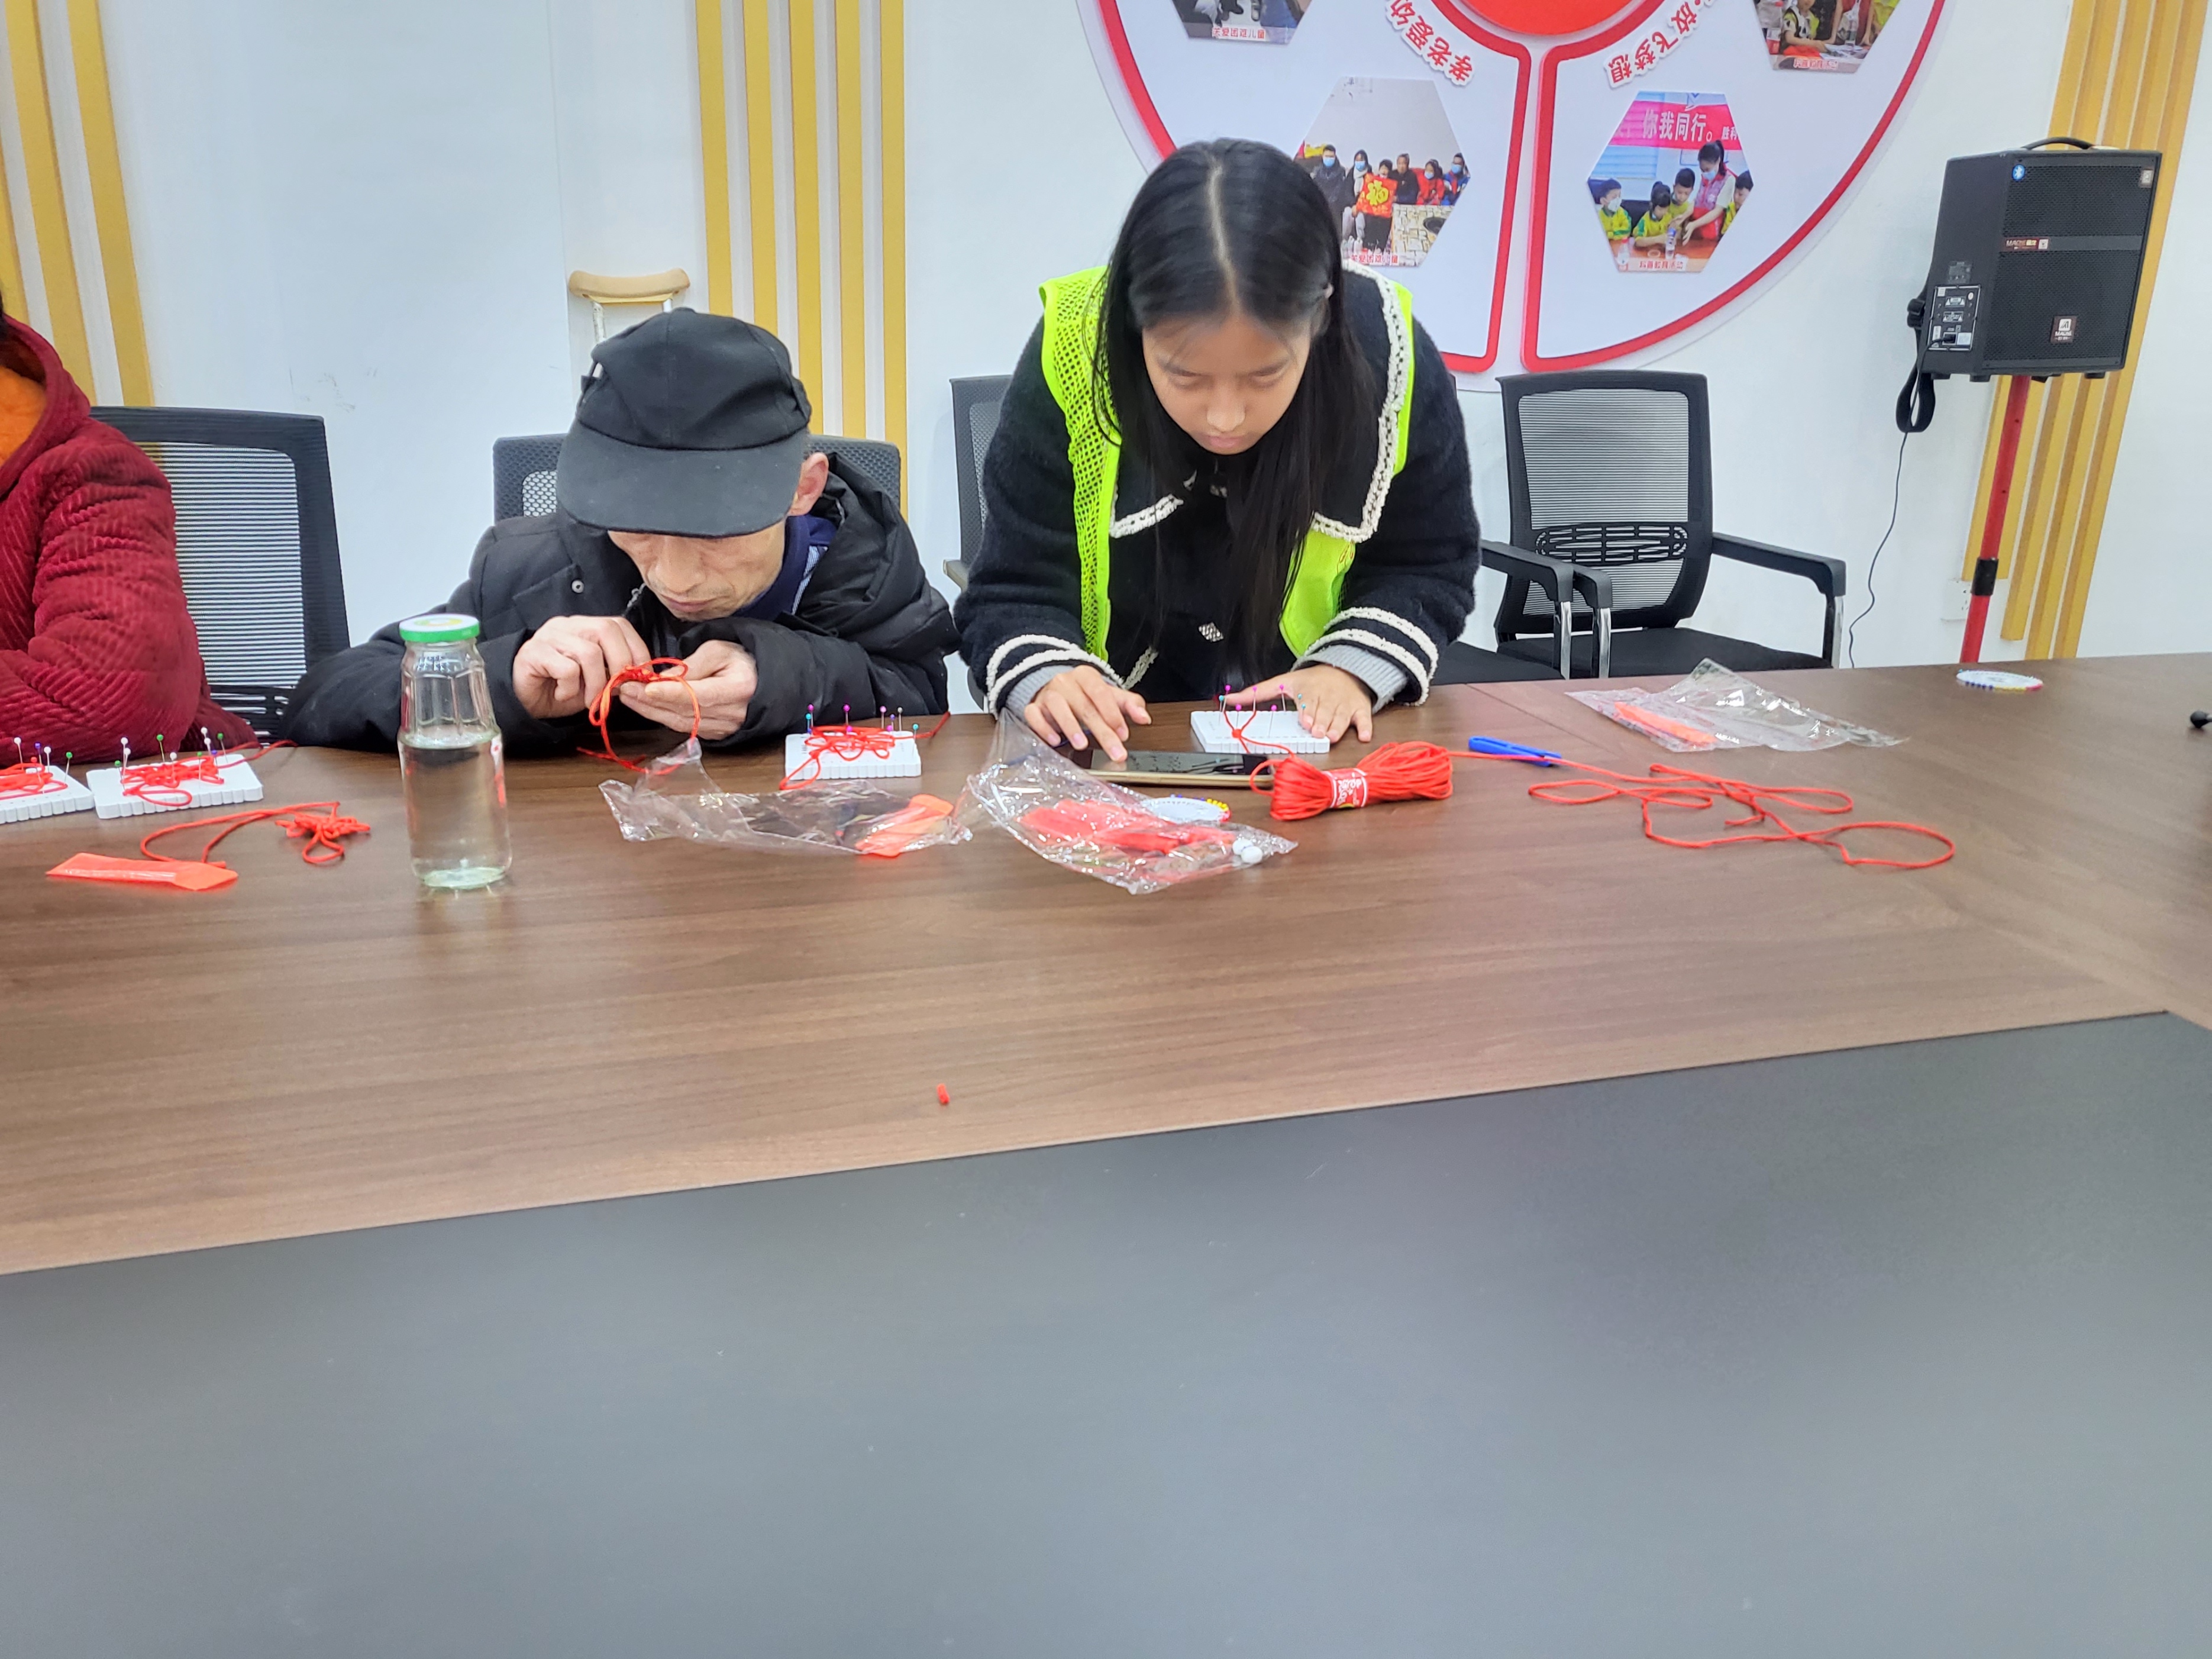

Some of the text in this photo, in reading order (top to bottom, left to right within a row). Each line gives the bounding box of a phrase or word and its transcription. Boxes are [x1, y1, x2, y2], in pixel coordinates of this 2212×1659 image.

[1213, 28, 1265, 39] 关爱困难儿童
[1390, 0, 1472, 82] 孝老爱幼
